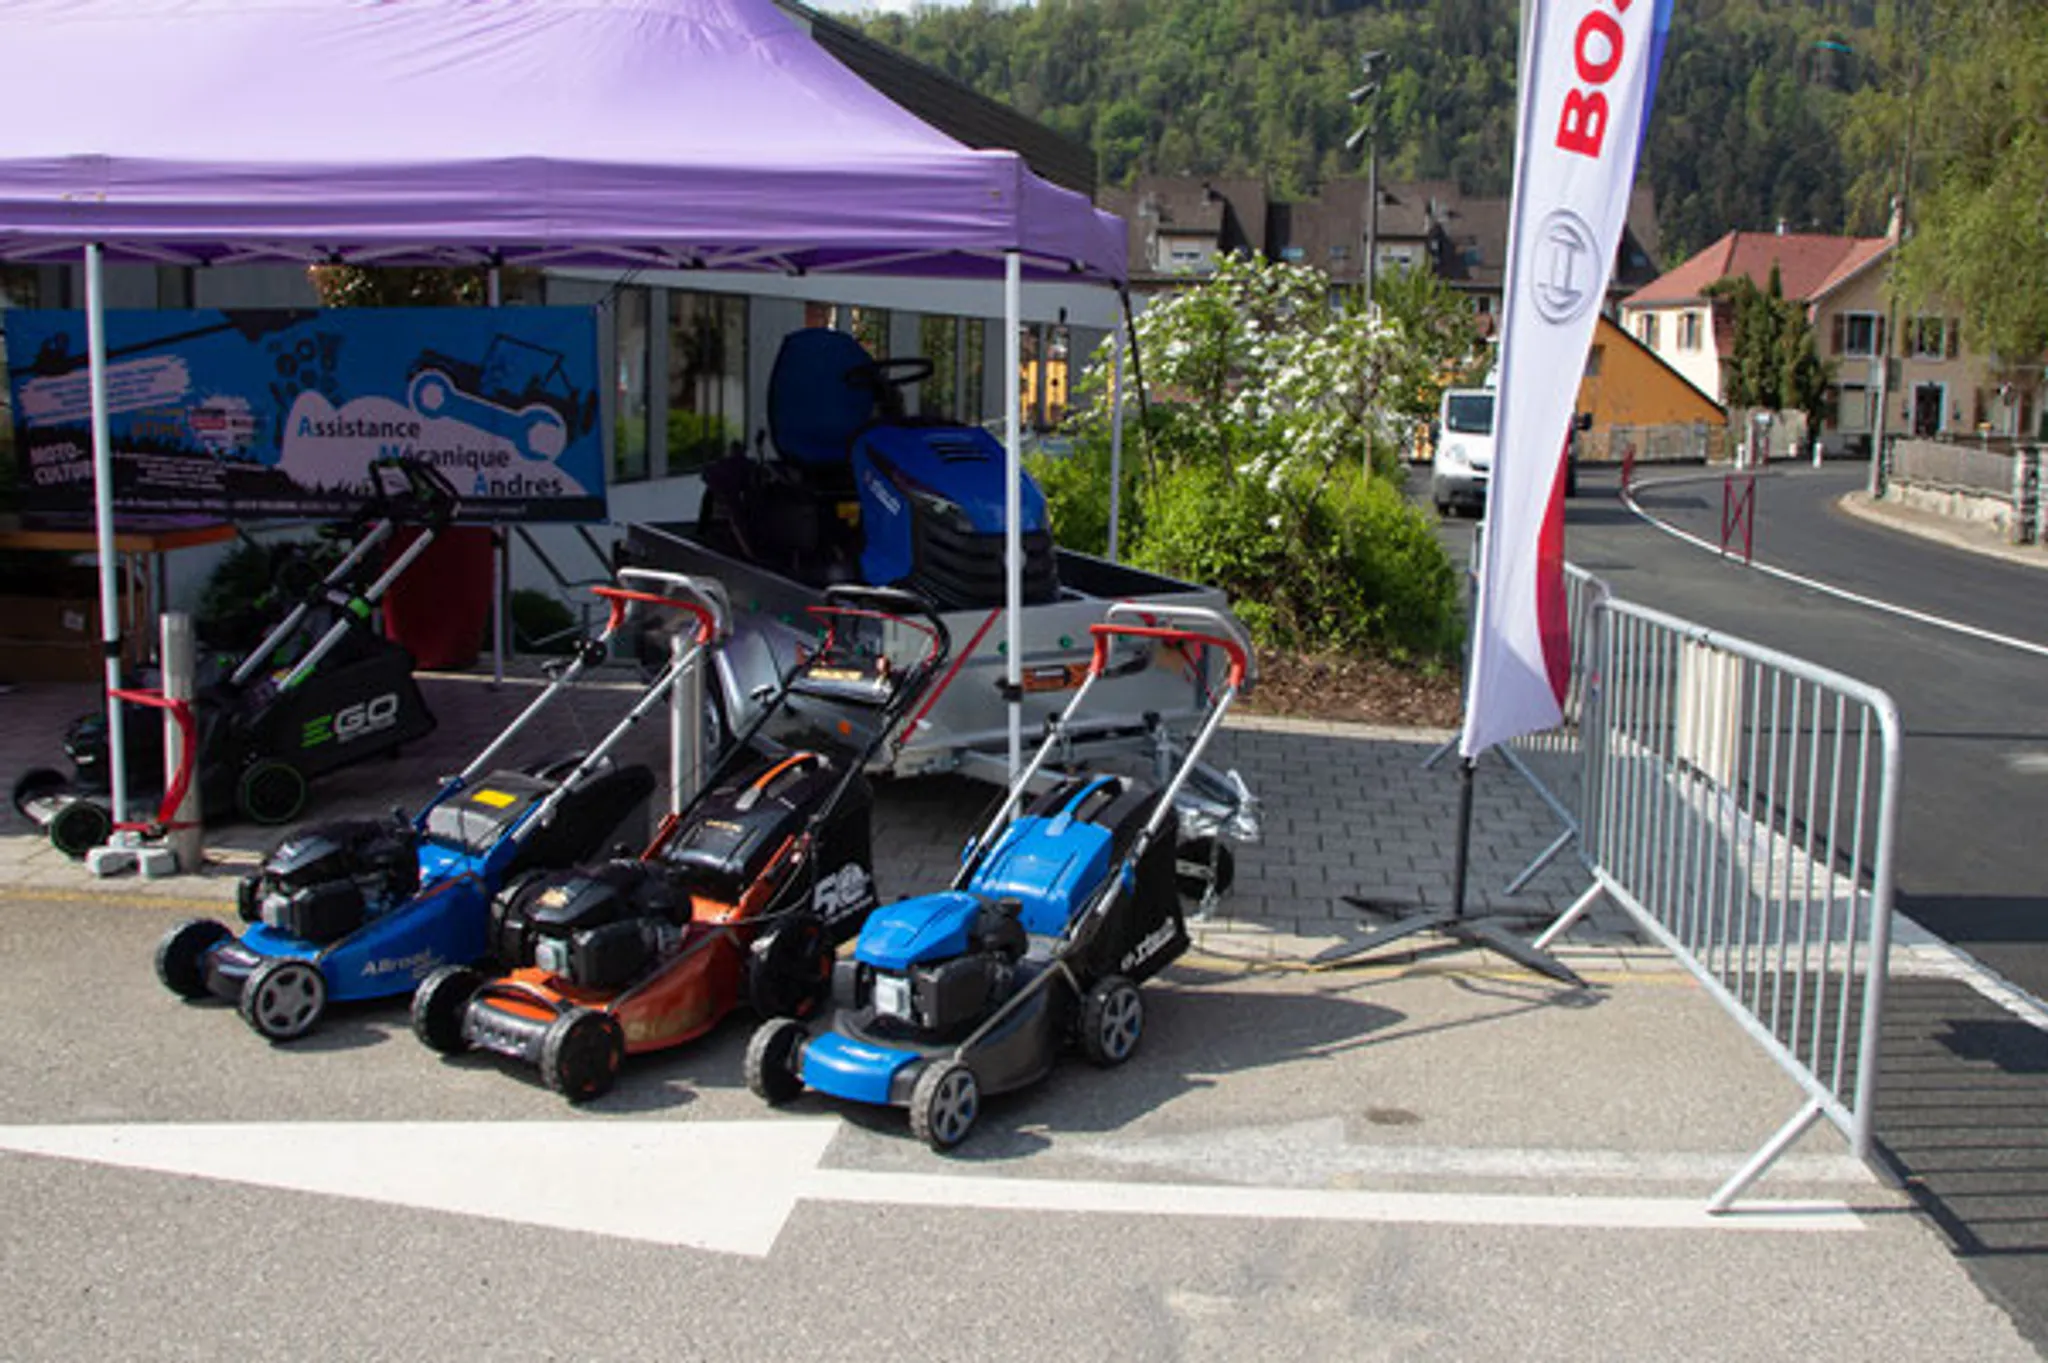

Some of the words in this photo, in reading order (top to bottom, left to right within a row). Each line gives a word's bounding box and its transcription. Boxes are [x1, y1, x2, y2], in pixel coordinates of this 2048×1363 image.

[1555, 0, 1632, 158] BO
[297, 416, 421, 437] Assistance
[378, 443, 511, 470] Mécanique
[473, 472, 564, 496] Andres
[299, 691, 400, 748] EGO
